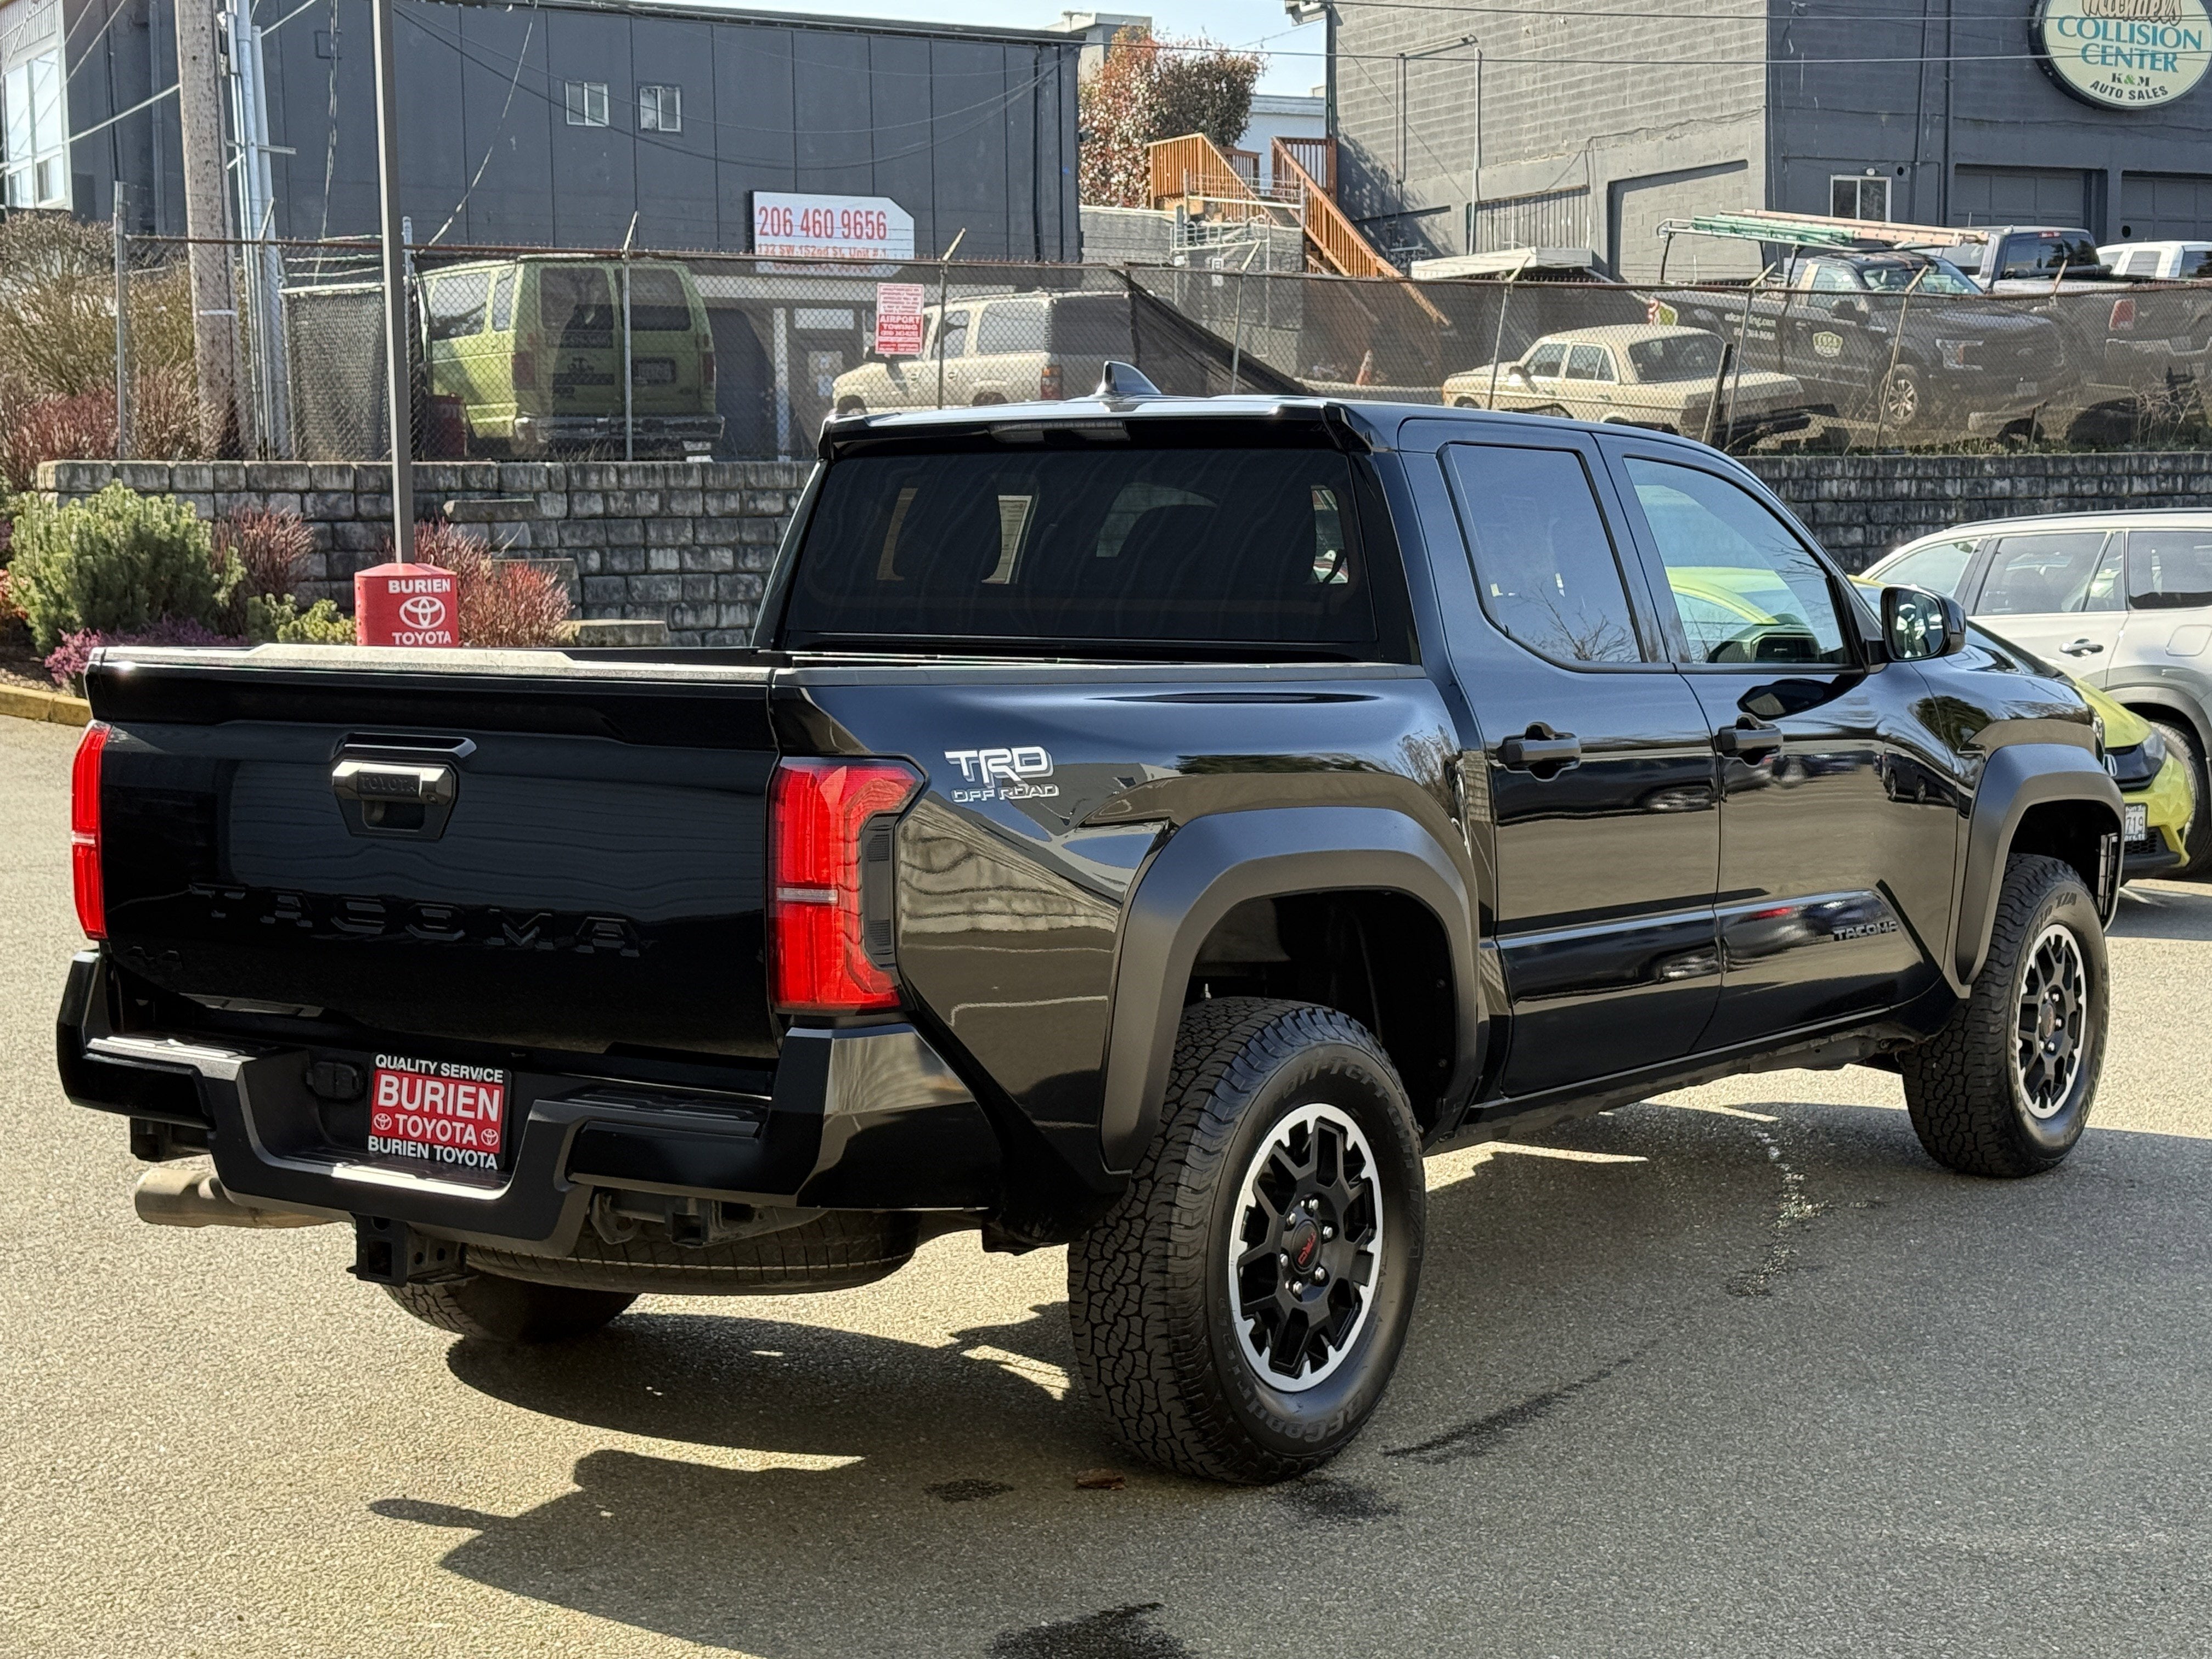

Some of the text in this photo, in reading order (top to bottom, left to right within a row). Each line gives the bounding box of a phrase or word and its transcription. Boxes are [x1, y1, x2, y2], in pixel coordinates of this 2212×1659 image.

[2057, 15, 2202, 50] COLLISION
[2081, 43, 2179, 73] CENTER
[2089, 80, 2169, 100] AUTO SALES
[2111, 72, 2150, 87] K&M
[758, 206, 887, 240] 206 460 9656
[879, 315, 921, 324] AIRPORT
[388, 578, 451, 594] BURIEN
[392, 631, 452, 645] TOYOTA
[944, 746, 1054, 788] TRD
[951, 783, 1060, 803] OFF ROAD
[188, 883, 641, 957] TACOMA
[1832, 921, 1899, 941] TACOMA
[375, 1054, 504, 1084] QUALITY SERVICE
[377, 1074, 500, 1122] BURIEN
[394, 1113, 478, 1147] TOYOTA
[368, 1135, 499, 1171] BURIEN TOYOTA
